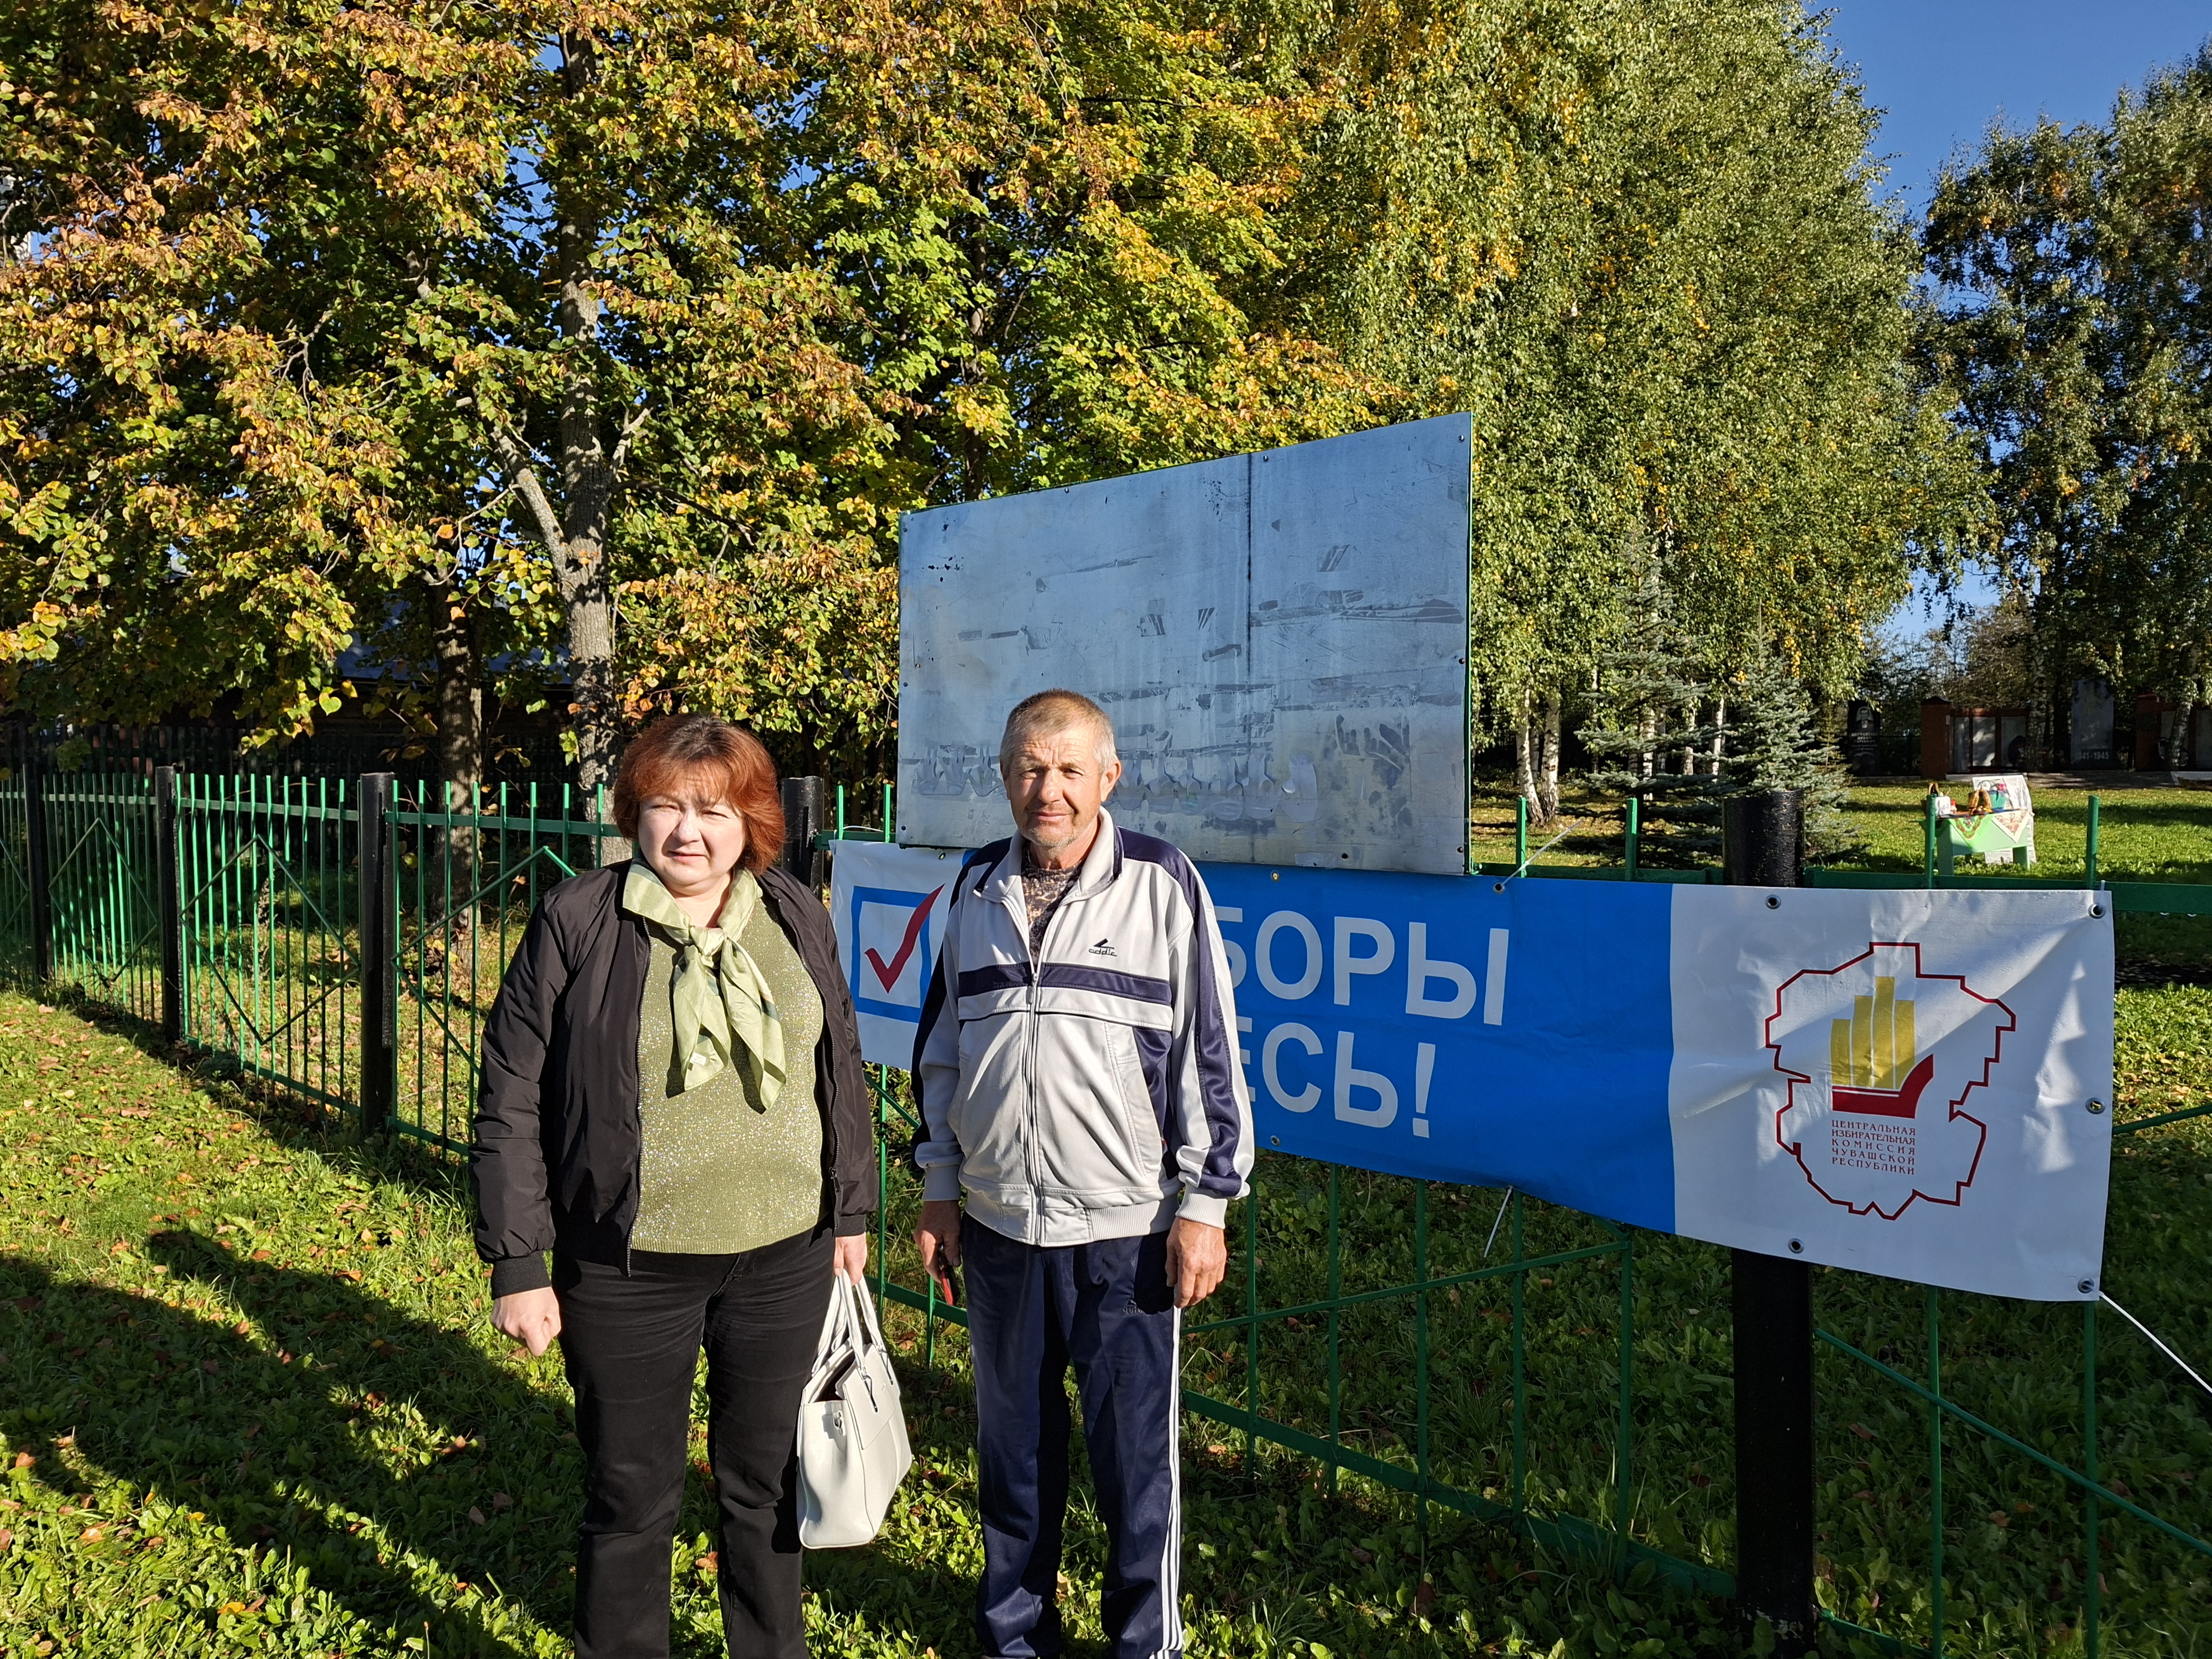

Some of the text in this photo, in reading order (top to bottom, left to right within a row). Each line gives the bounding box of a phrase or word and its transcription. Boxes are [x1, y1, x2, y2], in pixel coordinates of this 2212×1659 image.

[1214, 906, 1509, 1025] ОРЫ
[1237, 1016, 1436, 1138] СЬ!
[1832, 1119, 1916, 1135] ЦЕНТРАЛЬНАЯ
[1832, 1129, 1916, 1145] ИЗБИРАТЕЛЬНАЯ
[1832, 1139, 1915, 1155] КОМИССИЯ
[1832, 1147, 1914, 1165] ЧУВАШСКОЙ
[1832, 1157, 1914, 1175] РЕСПУБЛИКИ
